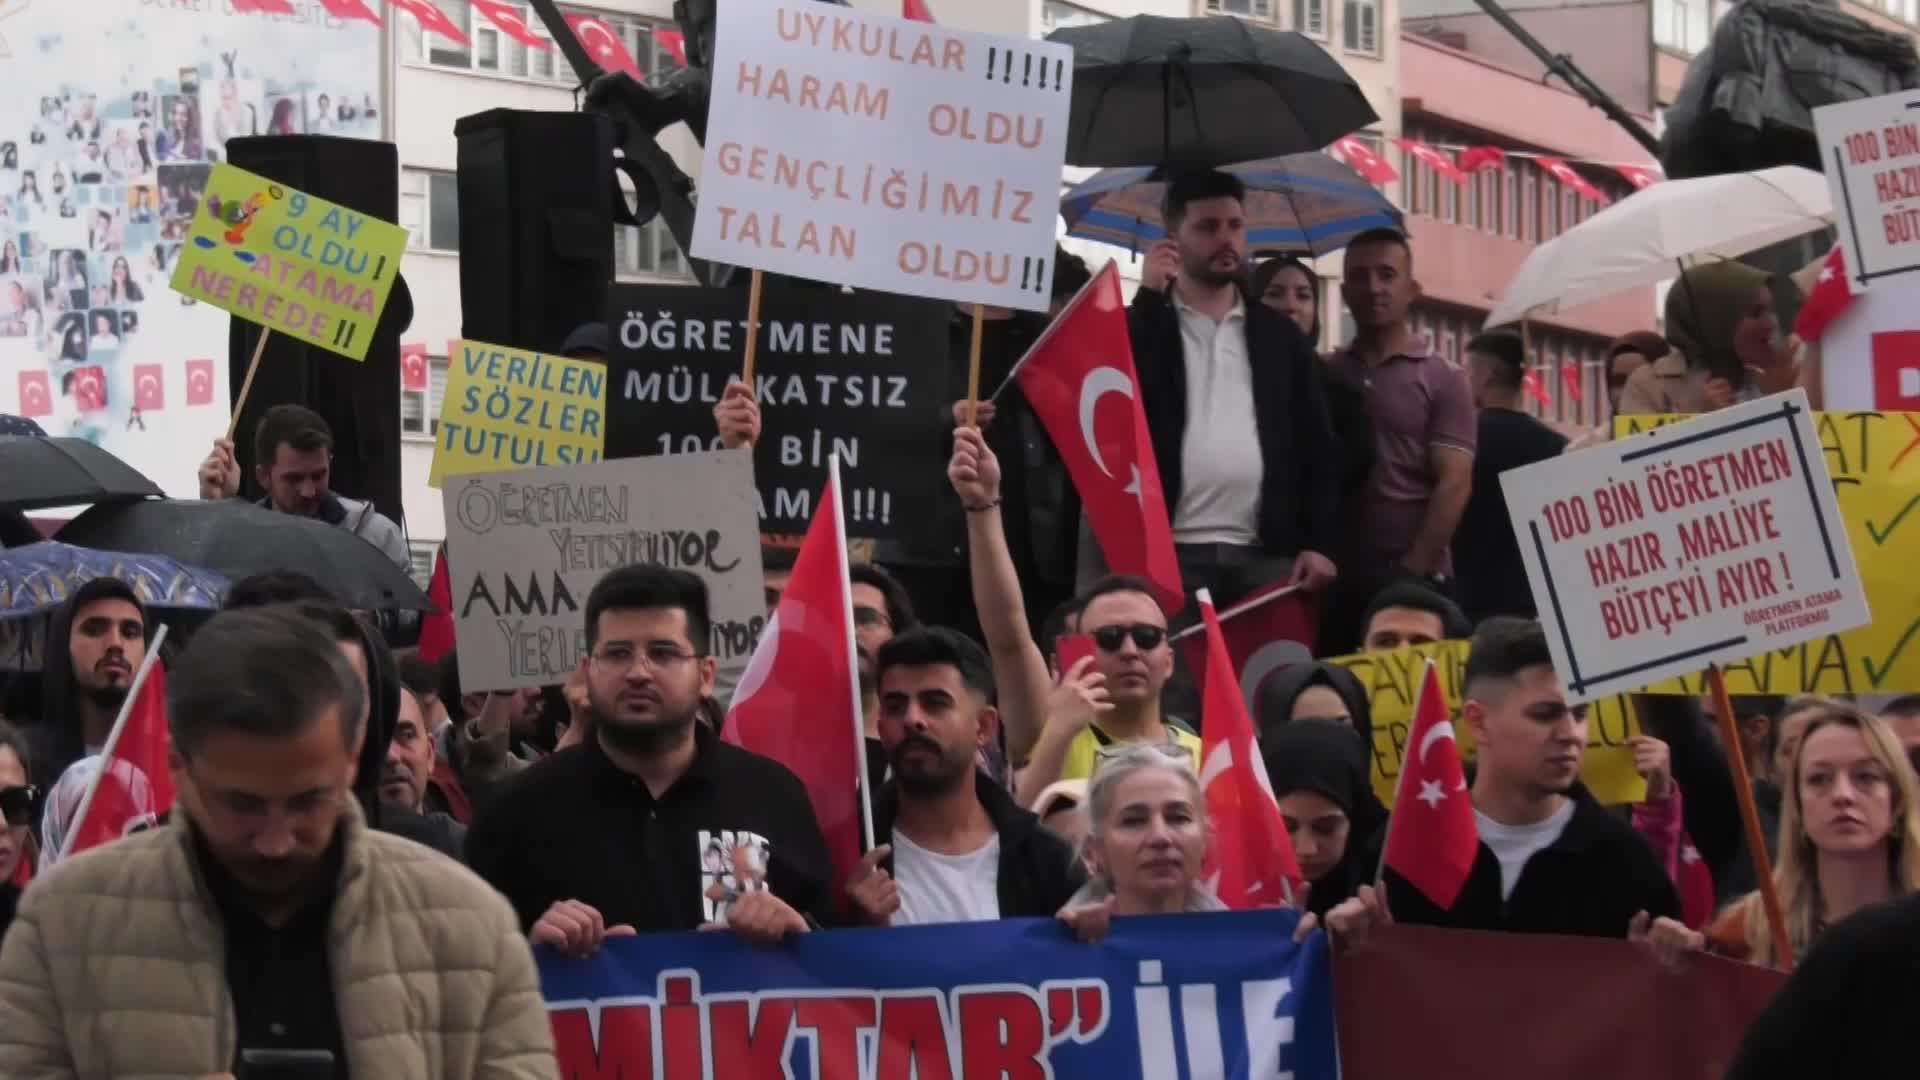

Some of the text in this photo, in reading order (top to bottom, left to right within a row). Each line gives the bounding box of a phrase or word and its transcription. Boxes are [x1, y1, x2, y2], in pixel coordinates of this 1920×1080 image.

[777, 8, 965, 71] UYKULAR
[737, 62, 1045, 149] HARAM OLDU
[1844, 131, 1880, 165] 100
[718, 142, 1035, 223] GENÇLİĞİMİZ
[1874, 164, 1920, 203] HAZI
[288, 193, 363, 241] 9 AY
[717, 207, 856, 261] TALAN
[251, 252, 376, 320] ATAMA
[464, 347, 603, 400] VERİLEN
[461, 385, 601, 438] SÖZLER
[781, 429, 859, 468] BİN
[1542, 496, 1591, 543] 100
[1594, 476, 1644, 530] BİN
[1645, 438, 1793, 513] ÖĞRETMEN
[1584, 532, 1666, 588] HAZIR
[461, 570, 578, 619] AMA
[1600, 567, 1713, 640] BÜTÇEYİ
[1720, 559, 1778, 609] AYIR
